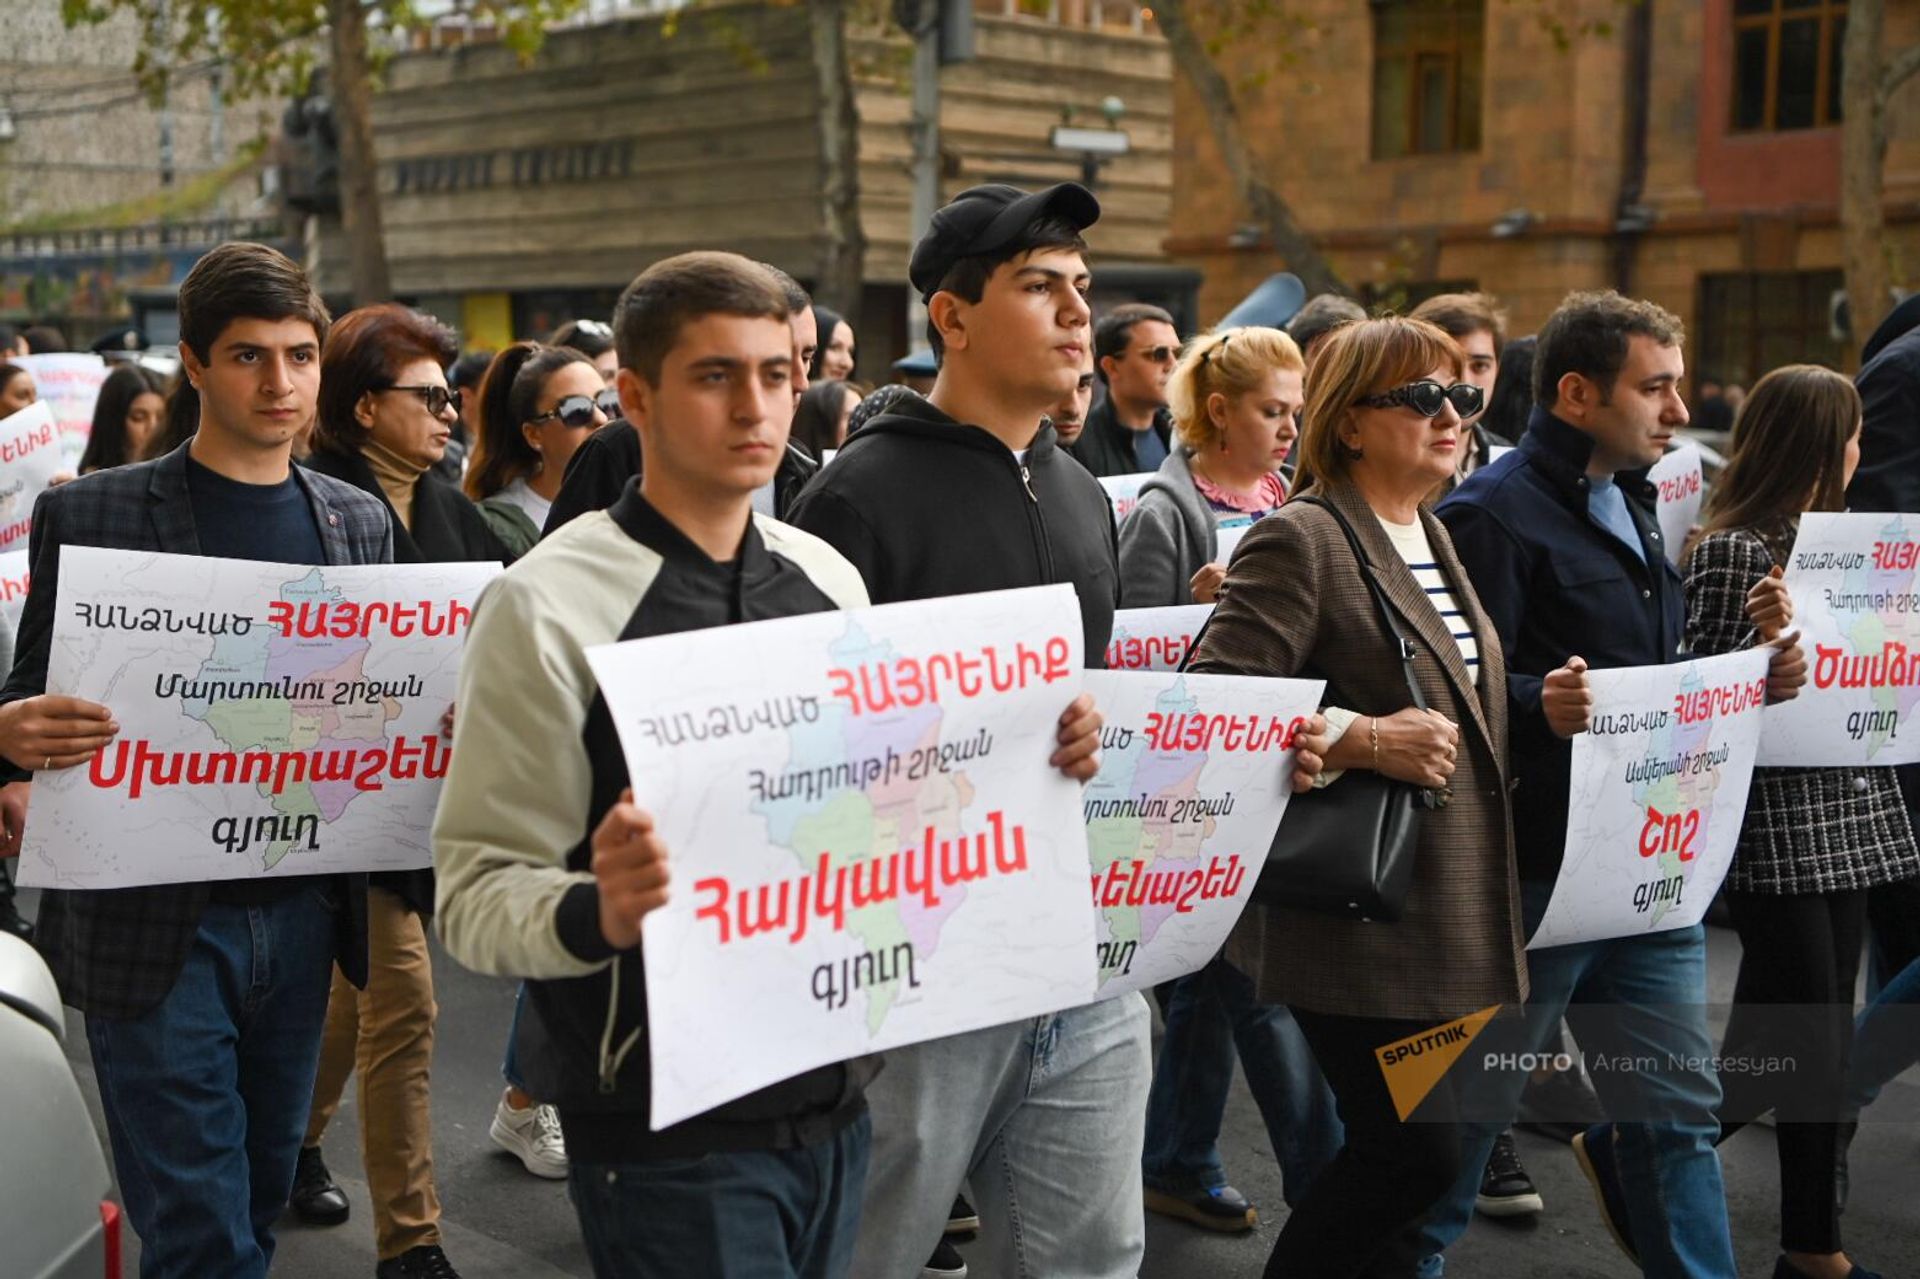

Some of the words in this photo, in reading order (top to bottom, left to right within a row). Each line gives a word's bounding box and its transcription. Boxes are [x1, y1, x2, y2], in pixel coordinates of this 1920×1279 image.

[2, 424, 52, 463] ԵՆԻՔ
[1659, 470, 1699, 502] ՐԵՆԻՔ
[1796, 552, 1865, 570] ՀԱՆՁՆՎԱԾ
[75, 602, 253, 636] ՀԱՆՁՆՎԱԾ
[268, 600, 471, 638] ՀԱՅՐԵՆԻ
[1824, 589, 1893, 614] Հադրութի
[1814, 642, 1920, 689] Ծամձո
[154, 673, 325, 704] Մարտունու
[332, 675, 423, 705] շրջան
[639, 695, 820, 747] ՀԱՆՁՆՎԱԾ
[827, 636, 1069, 716] ՀԱՅՐԵՆԻՔ
[1588, 710, 1668, 735] ԱՆՁՆՎԱԾ
[1674, 678, 1766, 725] ՀԱՅՐԵՆԻՔ
[1847, 709, 1898, 740] գյուղ
[89, 735, 452, 799] Սխտորաշեն
[749, 745, 900, 802] Հադրութի
[907, 728, 994, 781] շրջան
[1625, 750, 1691, 785] Ասկերանի
[1693, 742, 1729, 775] շրջան
[1084, 792, 1168, 825] րտունու
[1170, 792, 1235, 824] շրջան
[212, 814, 319, 853] գյուղ
[1639, 805, 1700, 862] Շոշ
[694, 810, 1029, 944] Հայկավան
[1091, 854, 1245, 913] ենաշեն
[1633, 875, 1683, 913] գյուղ
[811, 941, 920, 1011] գյուղ
[1097, 940, 1137, 975] ուղ
